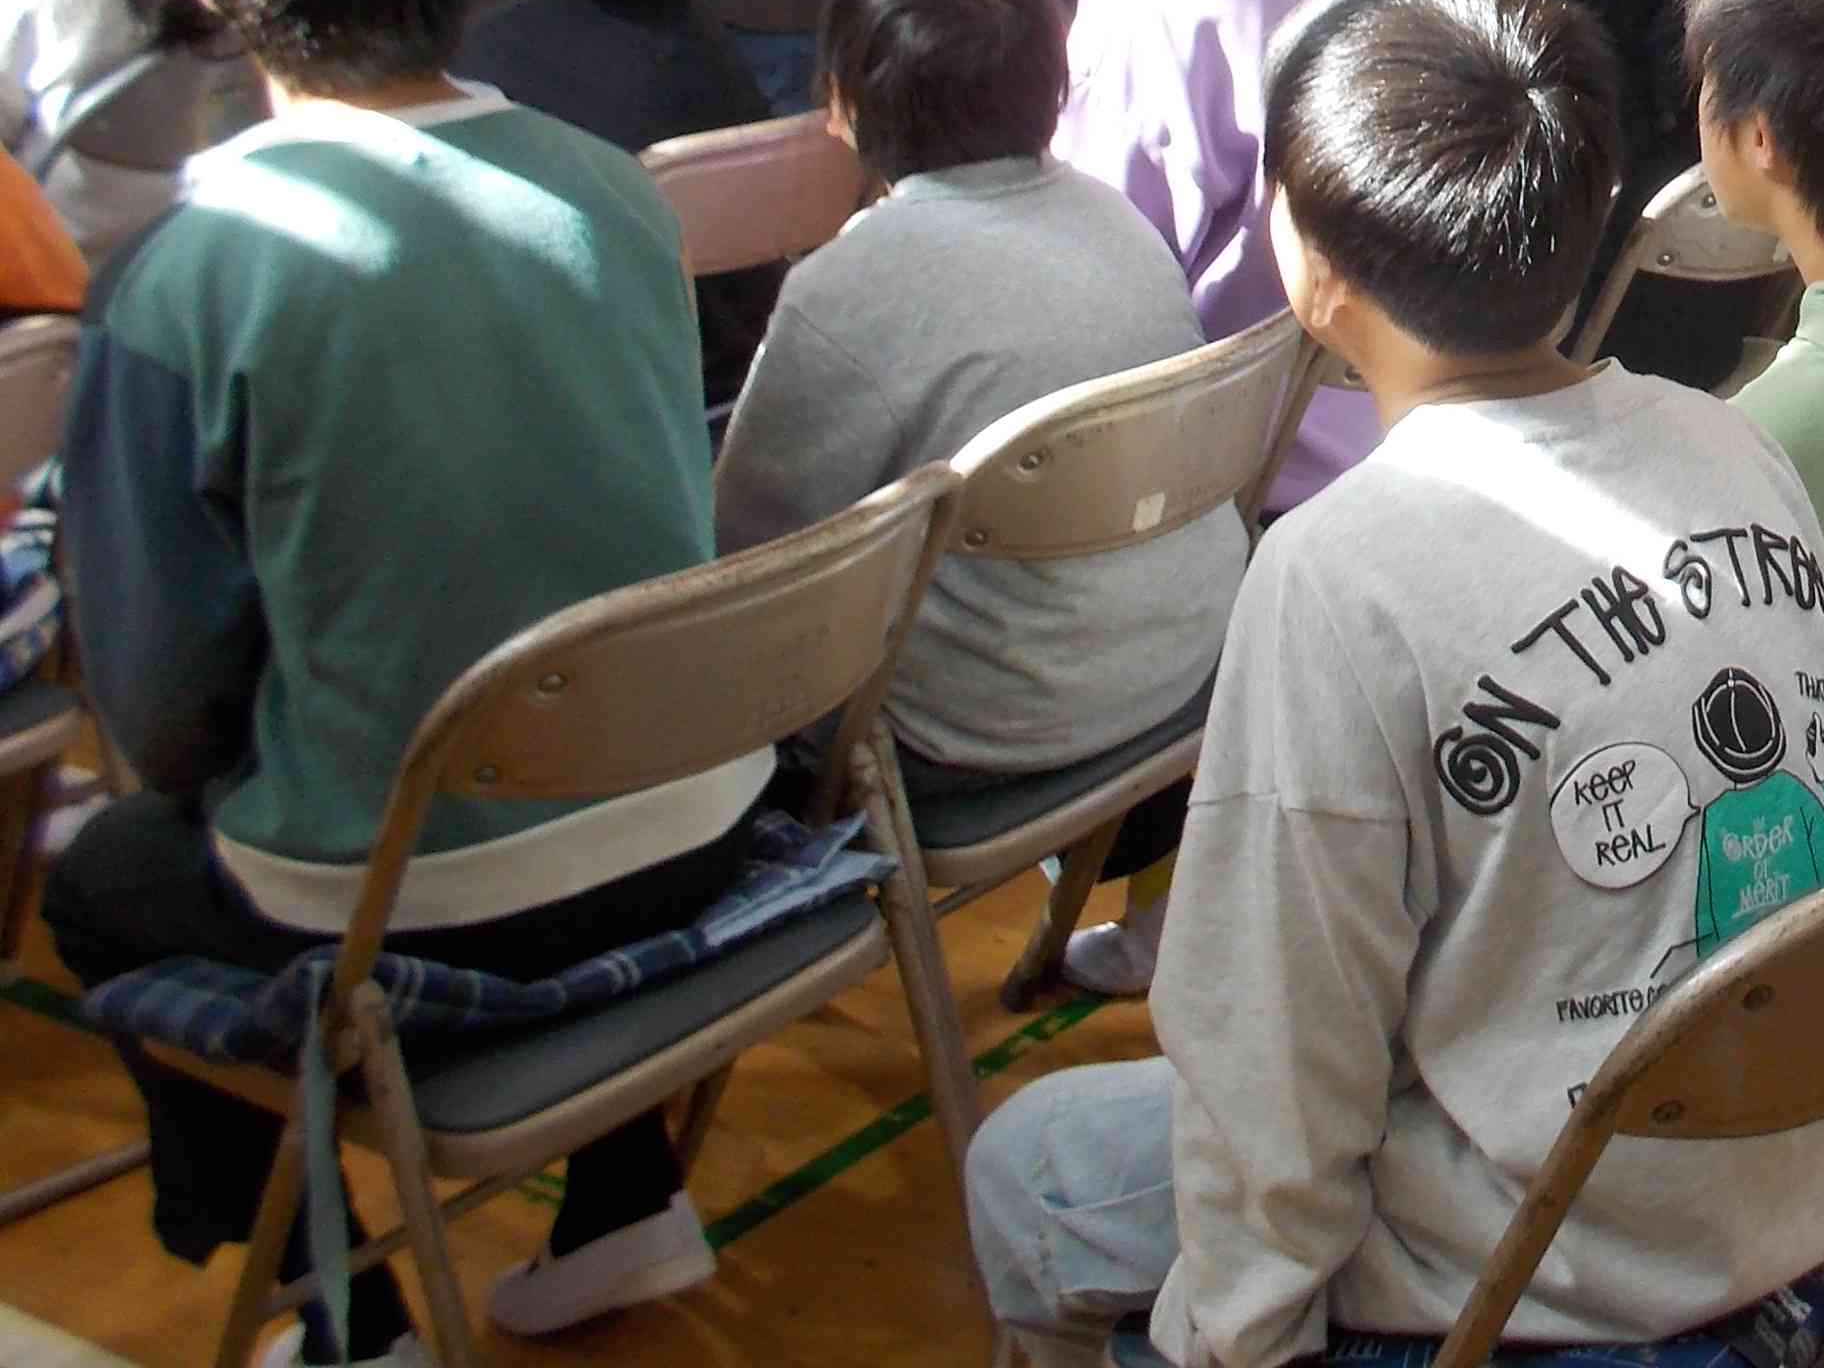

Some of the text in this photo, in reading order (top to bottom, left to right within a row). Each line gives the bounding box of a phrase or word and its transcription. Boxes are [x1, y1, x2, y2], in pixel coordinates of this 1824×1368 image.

[1433, 674, 1561, 816] ON
[1510, 565, 1667, 686] THE
[1573, 759, 1637, 806] KEEP
[1600, 798, 1626, 832] IT
[1594, 823, 1667, 867] REAL
